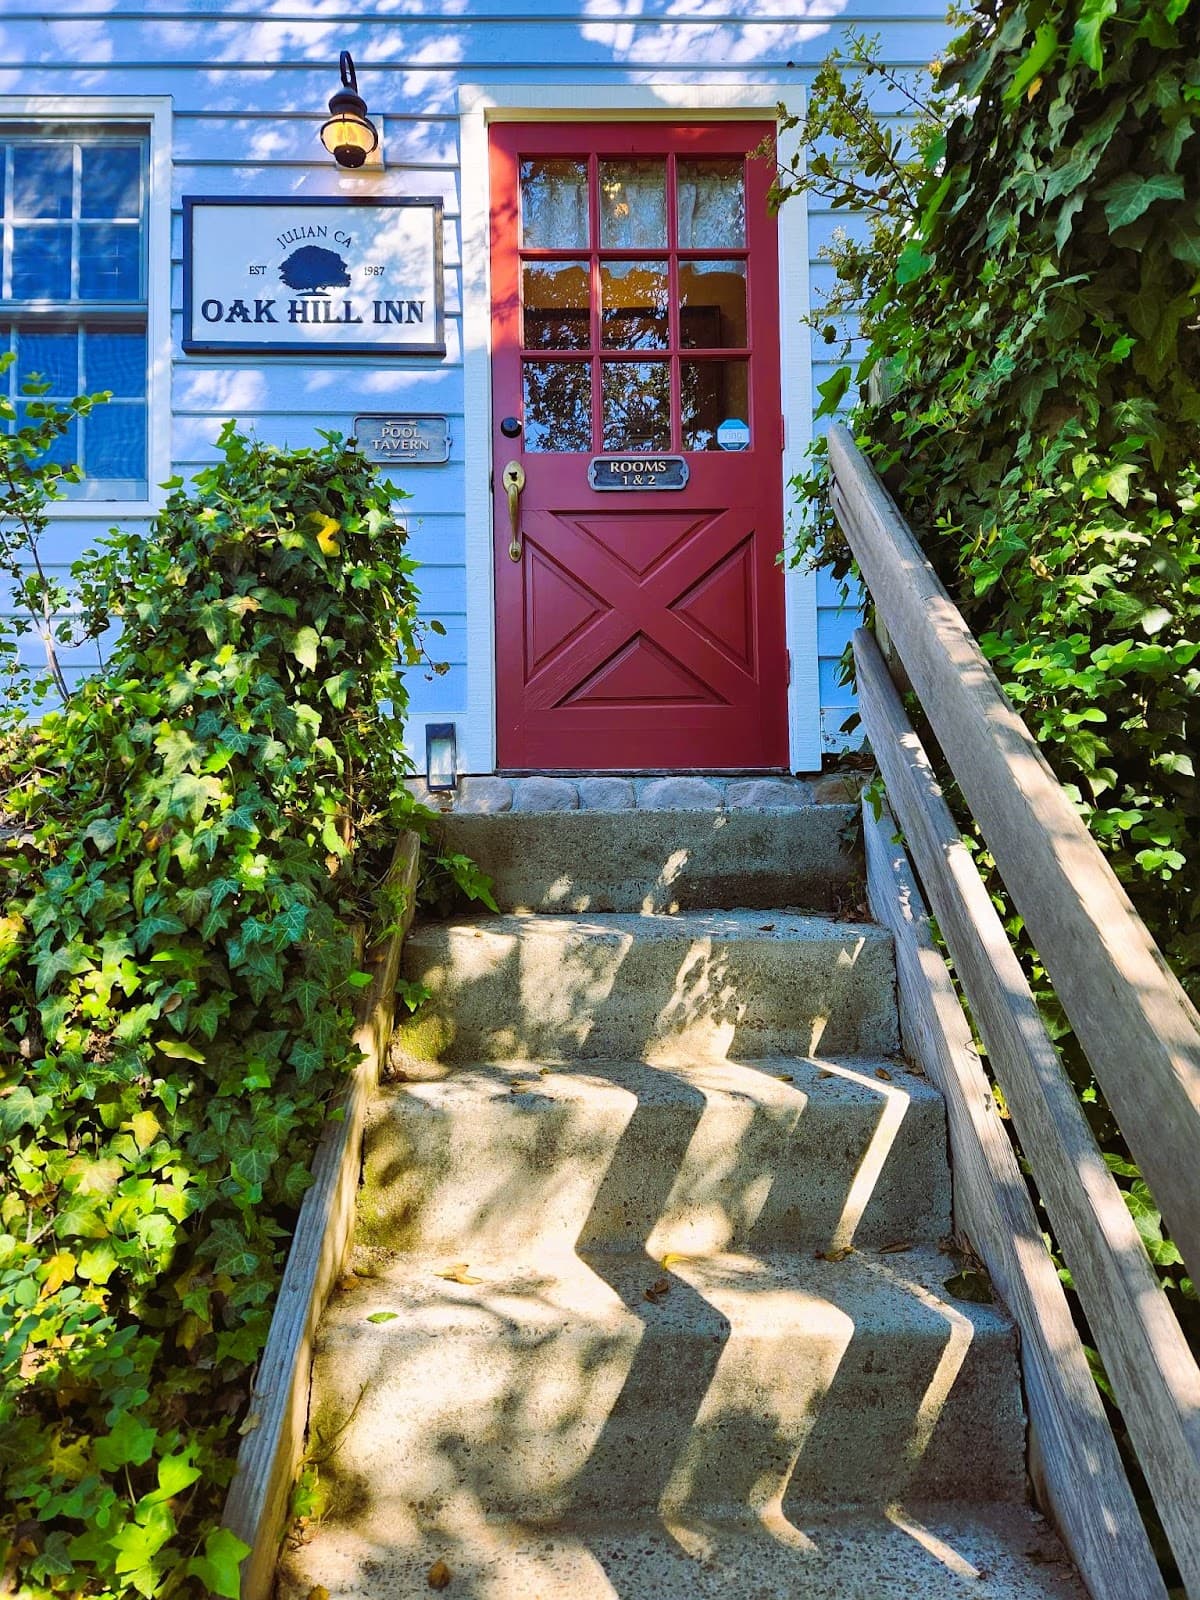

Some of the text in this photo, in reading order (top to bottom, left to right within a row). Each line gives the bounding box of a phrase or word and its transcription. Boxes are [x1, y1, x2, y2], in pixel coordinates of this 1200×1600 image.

[276, 225, 352, 250] JULIAN CA
[249, 265, 385, 276] EST 1987
[201, 299, 425, 323] OAK HILL INN
[381, 427, 422, 438] POOL
[372, 439, 429, 450] TAVERN
[610, 461, 666, 473] ROOMS
[622, 475, 656, 485] 1 & 2
